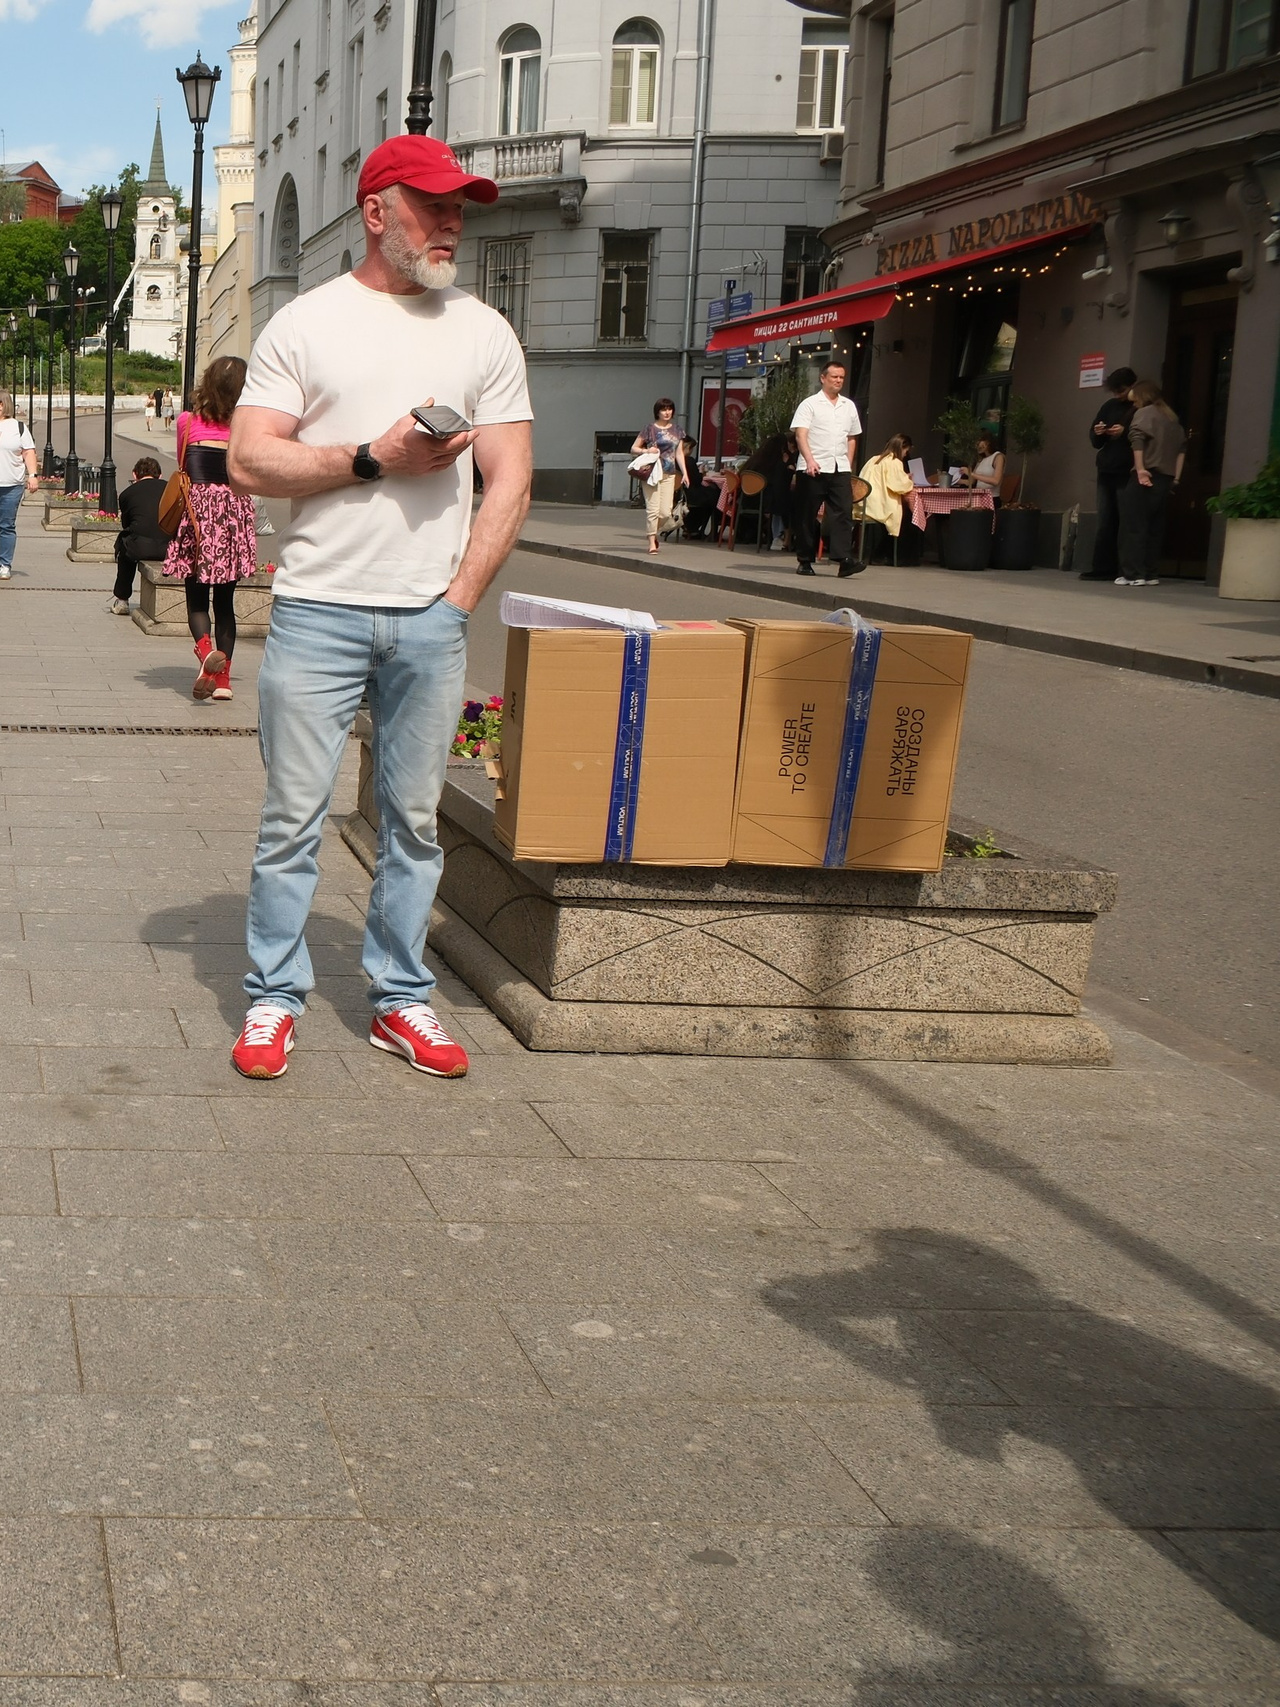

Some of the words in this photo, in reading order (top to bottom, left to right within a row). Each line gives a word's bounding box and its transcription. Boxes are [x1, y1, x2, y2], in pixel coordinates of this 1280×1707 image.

[874, 233, 937, 276] PIZZA
[753, 324, 777, 337] ПИЦЦА
[778, 322, 788, 333] 22
[788, 311, 838, 330] САНТИМЕТРА
[778, 718, 799, 778] POWER
[795, 702, 816, 767] CREATE
[886, 705, 911, 797] ЗАРЯЖАТЬ
[901, 708, 925, 796] СОЗДАНЫ
[791, 772, 807, 795] TO
[616, 806, 626, 836] VOLTUM
